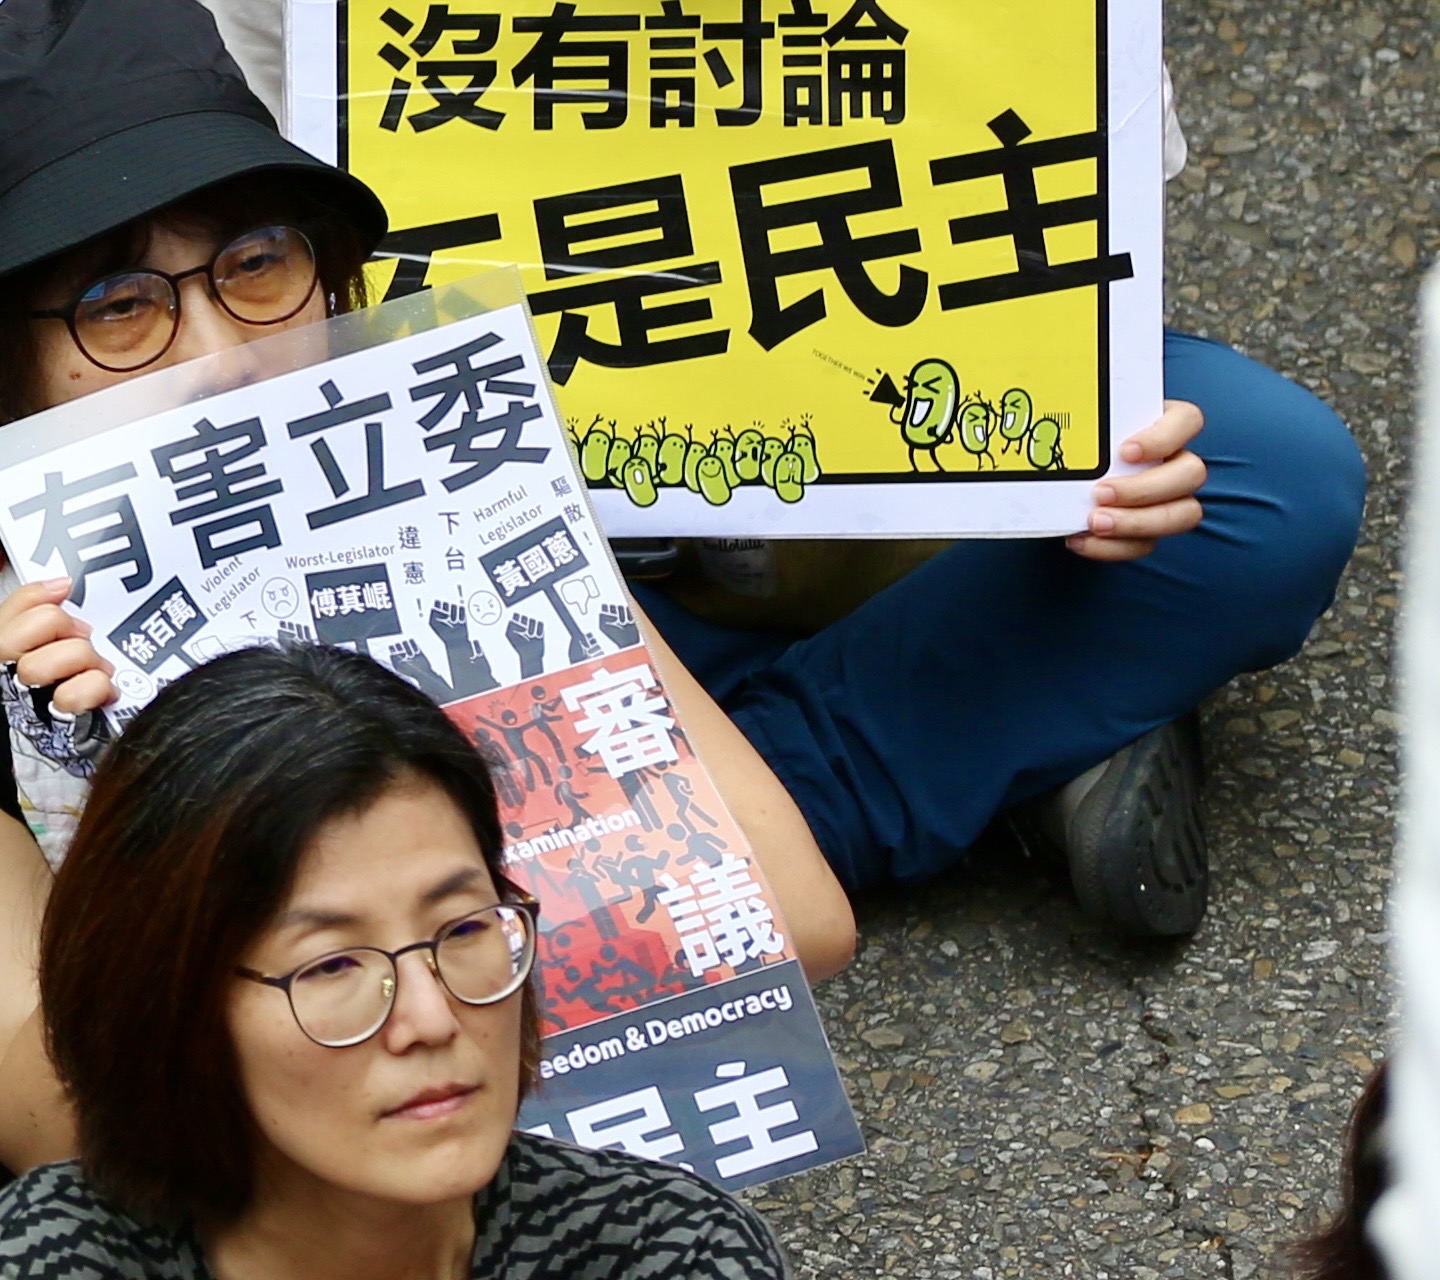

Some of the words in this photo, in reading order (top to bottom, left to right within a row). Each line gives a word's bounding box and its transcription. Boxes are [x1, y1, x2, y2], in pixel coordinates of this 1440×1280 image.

[9, 332, 551, 610] 有害立委
[472, 484, 529, 523] Harmful
[478, 503, 545, 547] Legislator
[201, 554, 245, 595] Violent
[284, 542, 397, 572] Worst-Legislator
[206, 566, 262, 618] Legislator
[559, 662, 679, 779] 審
[501, 807, 641, 868] xamination
[656, 852, 785, 978] 議
[538, 1037, 625, 1079] eedom
[626, 1026, 648, 1051] &
[645, 983, 794, 1046] Democracy
[522, 1060, 819, 1179] 民主
